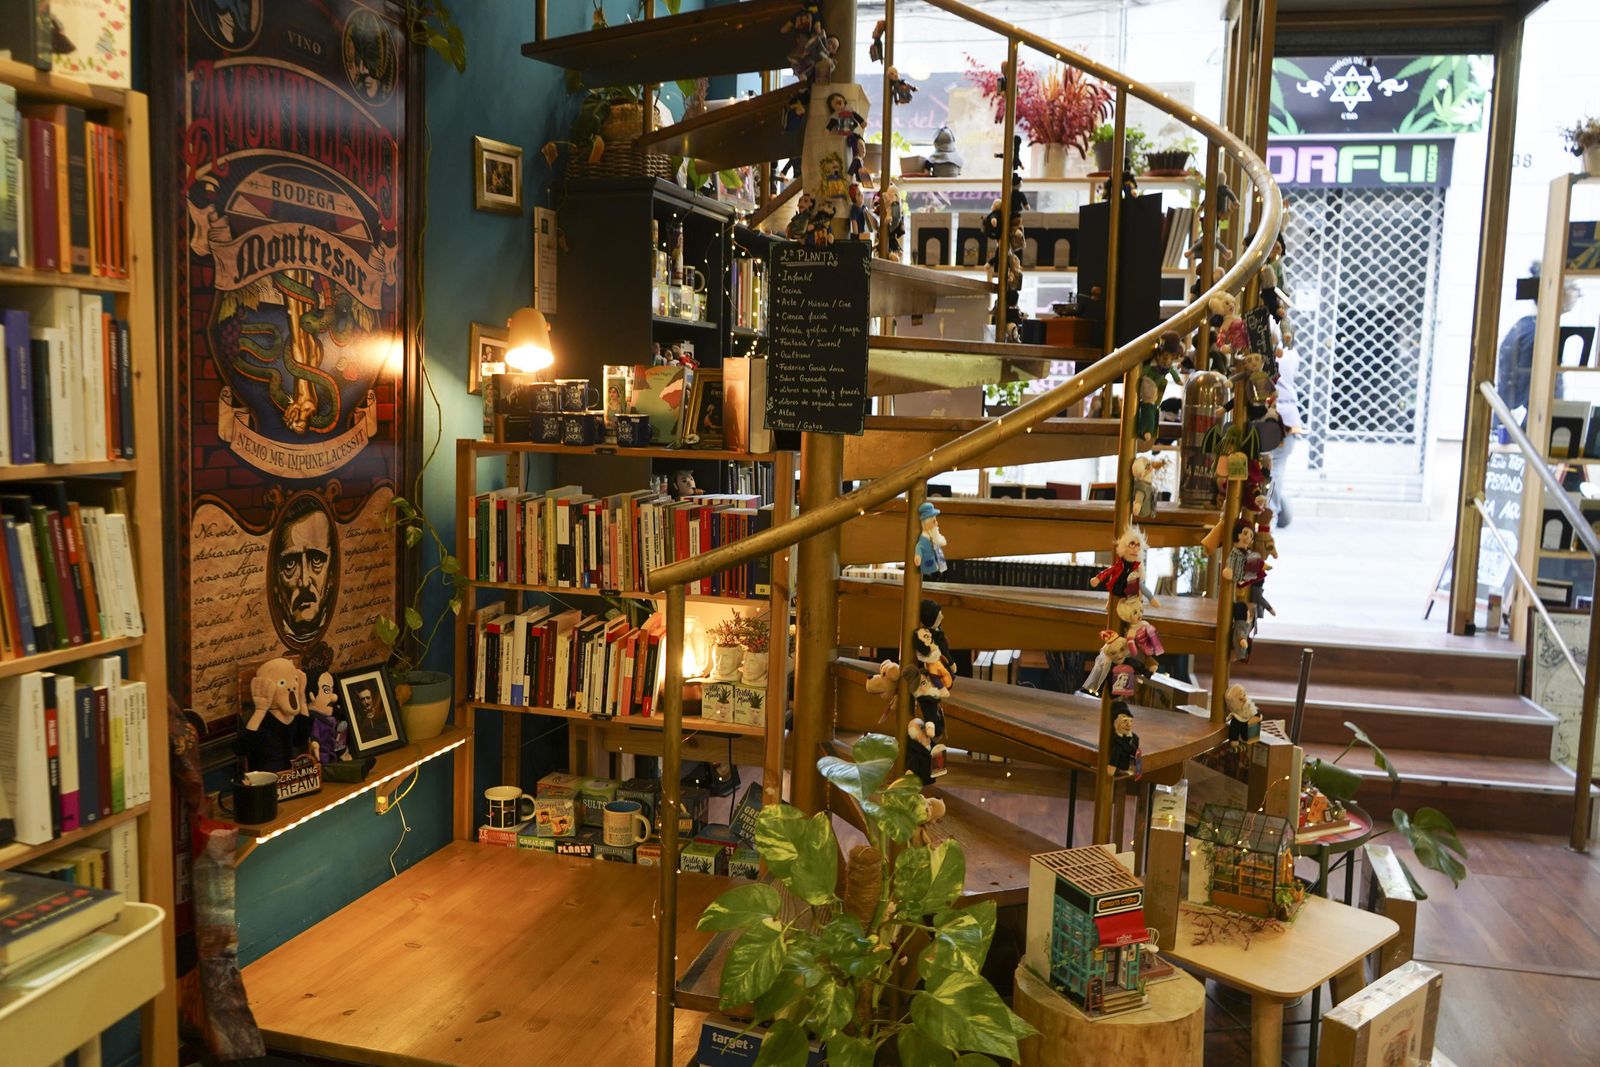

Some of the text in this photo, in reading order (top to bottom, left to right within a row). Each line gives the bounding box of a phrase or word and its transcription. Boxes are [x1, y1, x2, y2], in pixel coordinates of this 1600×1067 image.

[287, 30, 322, 55] VINO
[271, 179, 336, 210] BODEGA
[233, 224, 367, 296] Montresor
[781, 270, 813, 283] Infantil
[781, 285, 802, 295] Cocina
[781, 297, 797, 306] Arte
[807, 299, 829, 308] Música
[838, 300, 851, 308] Cine
[781, 312, 804, 320] Ciencia
[781, 325, 803, 334] Novela
[806, 325, 828, 338] gráfica
[839, 326, 861, 337] Manga
[779, 337, 808, 347] Fantasía
[816, 338, 841, 348] Juvenil
[779, 362, 845, 373] Federico García Lorca
[779, 375, 827, 383] Sobre Granada
[779, 386, 799, 394] Libros
[839, 386, 860, 397] francés
[811, 399, 835, 412] segunda
[778, 408, 796, 417] Atlas
[803, 420, 824, 431] Gatos
[237, 428, 366, 470] NEMO ME IMPUNE LACESSIT
[277, 766, 318, 785] CREAMING
[277, 778, 319, 799] REAM
[711, 1032, 749, 1050] target
